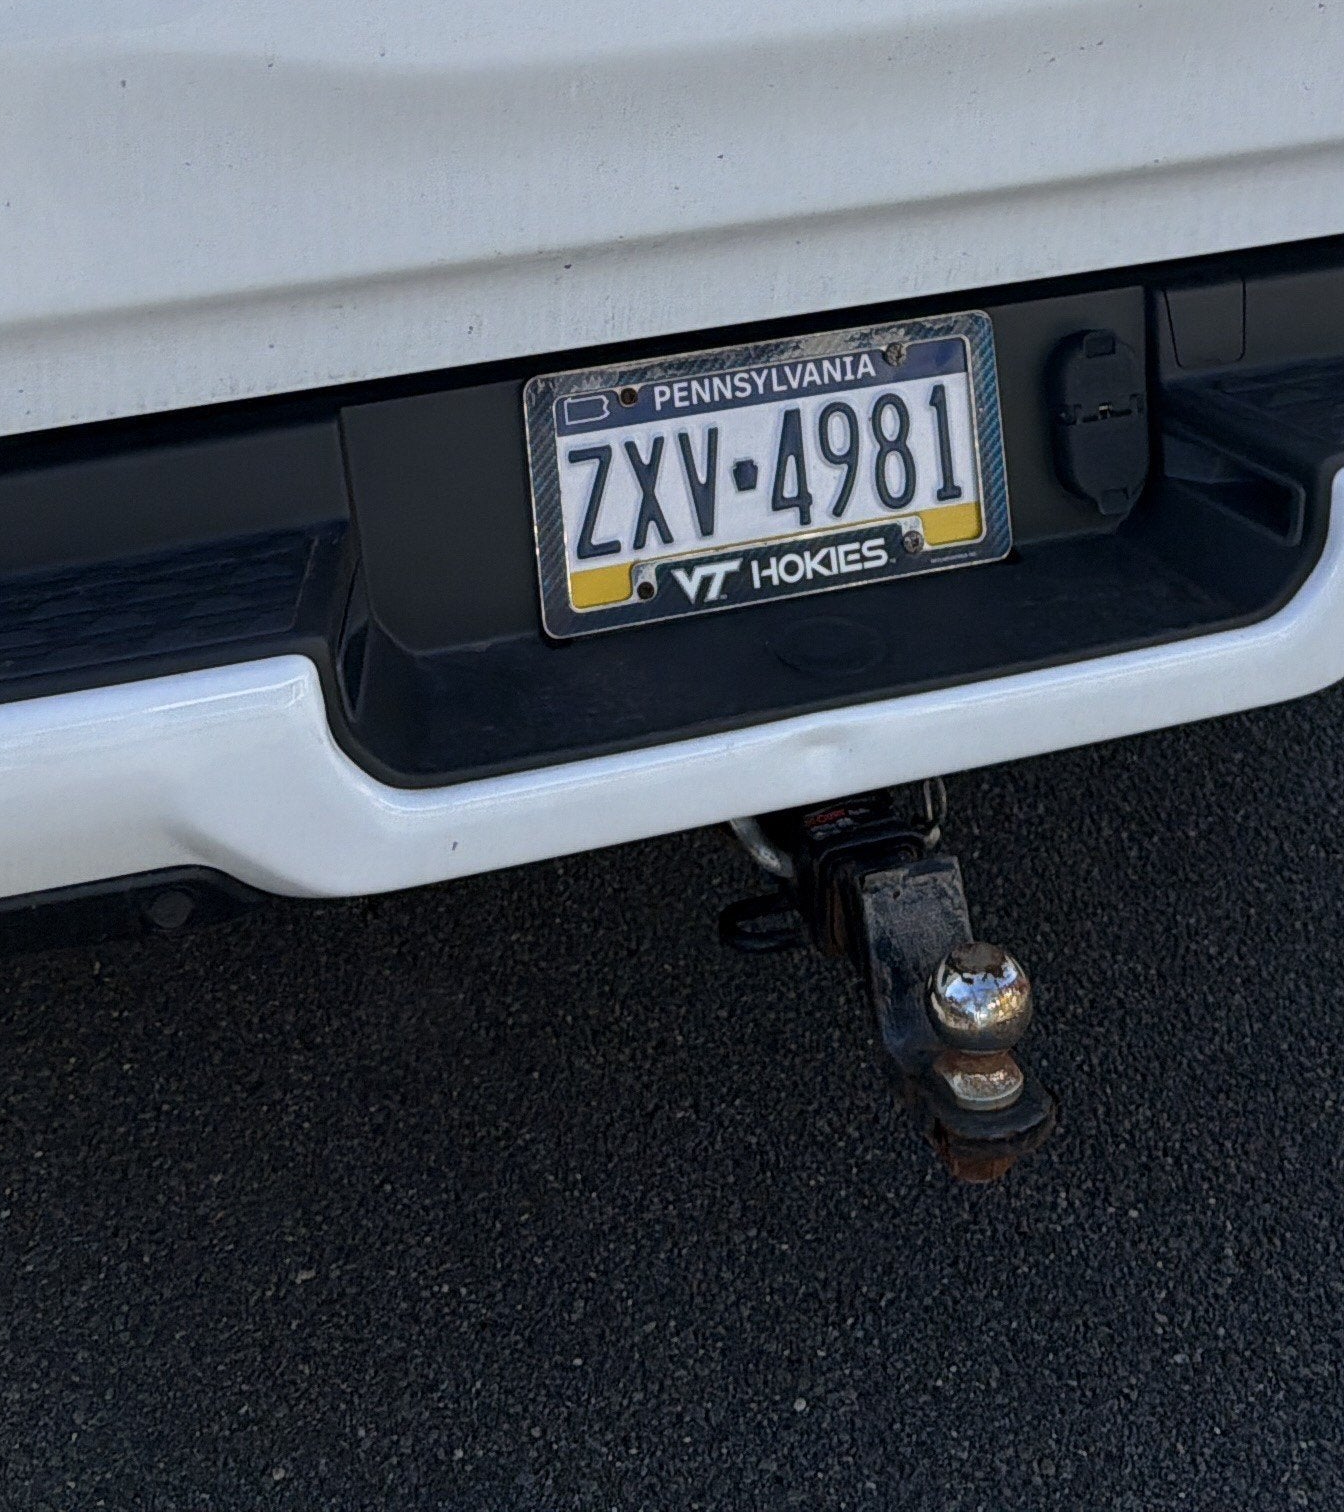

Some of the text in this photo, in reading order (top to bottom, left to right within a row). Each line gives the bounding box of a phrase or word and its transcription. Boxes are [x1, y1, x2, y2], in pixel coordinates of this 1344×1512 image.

[654, 353, 876, 412] PENNSYLVANIA
[672, 538, 888, 605] VT HOKIES
